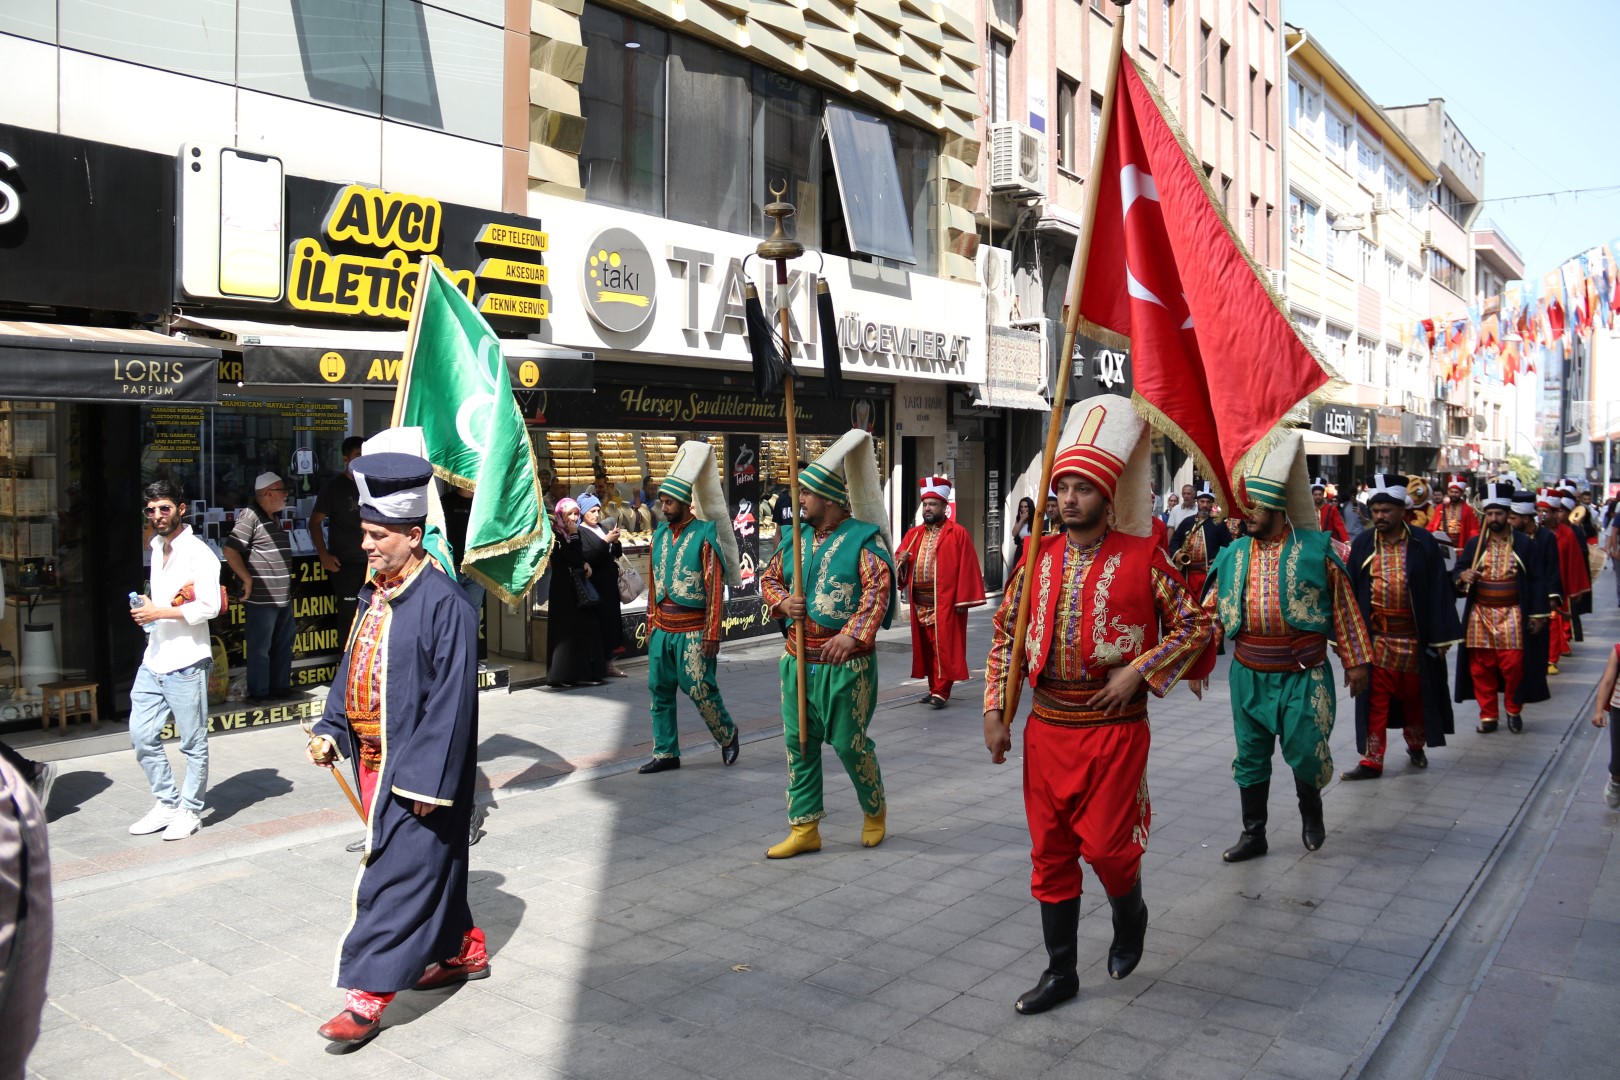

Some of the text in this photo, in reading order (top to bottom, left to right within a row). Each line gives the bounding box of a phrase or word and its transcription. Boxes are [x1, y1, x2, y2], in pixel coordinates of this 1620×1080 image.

[335, 193, 436, 244] AVCI
[491, 228, 545, 248] CEP TELEFONU
[296, 246, 468, 311] İLETİŞ
[505, 264, 545, 281] AKSESUAR
[666, 244, 817, 344] TAKI
[490, 297, 545, 315] TEKNİK SERVİS
[114, 358, 184, 384] LORIS
[123, 384, 174, 396] PARFUM
[620, 385, 682, 422] Herşey
[682, 393, 776, 422] Sevdikleriniz
[1325, 408, 1355, 434] HÜSEYİN
[300, 561, 328, 583] 2.EL
[293, 594, 338, 618] LARIN
[761, 604, 771, 626] &
[292, 628, 339, 653] ALINIR
[297, 663, 339, 686] SERVİ
[220, 712, 246, 730] VE
